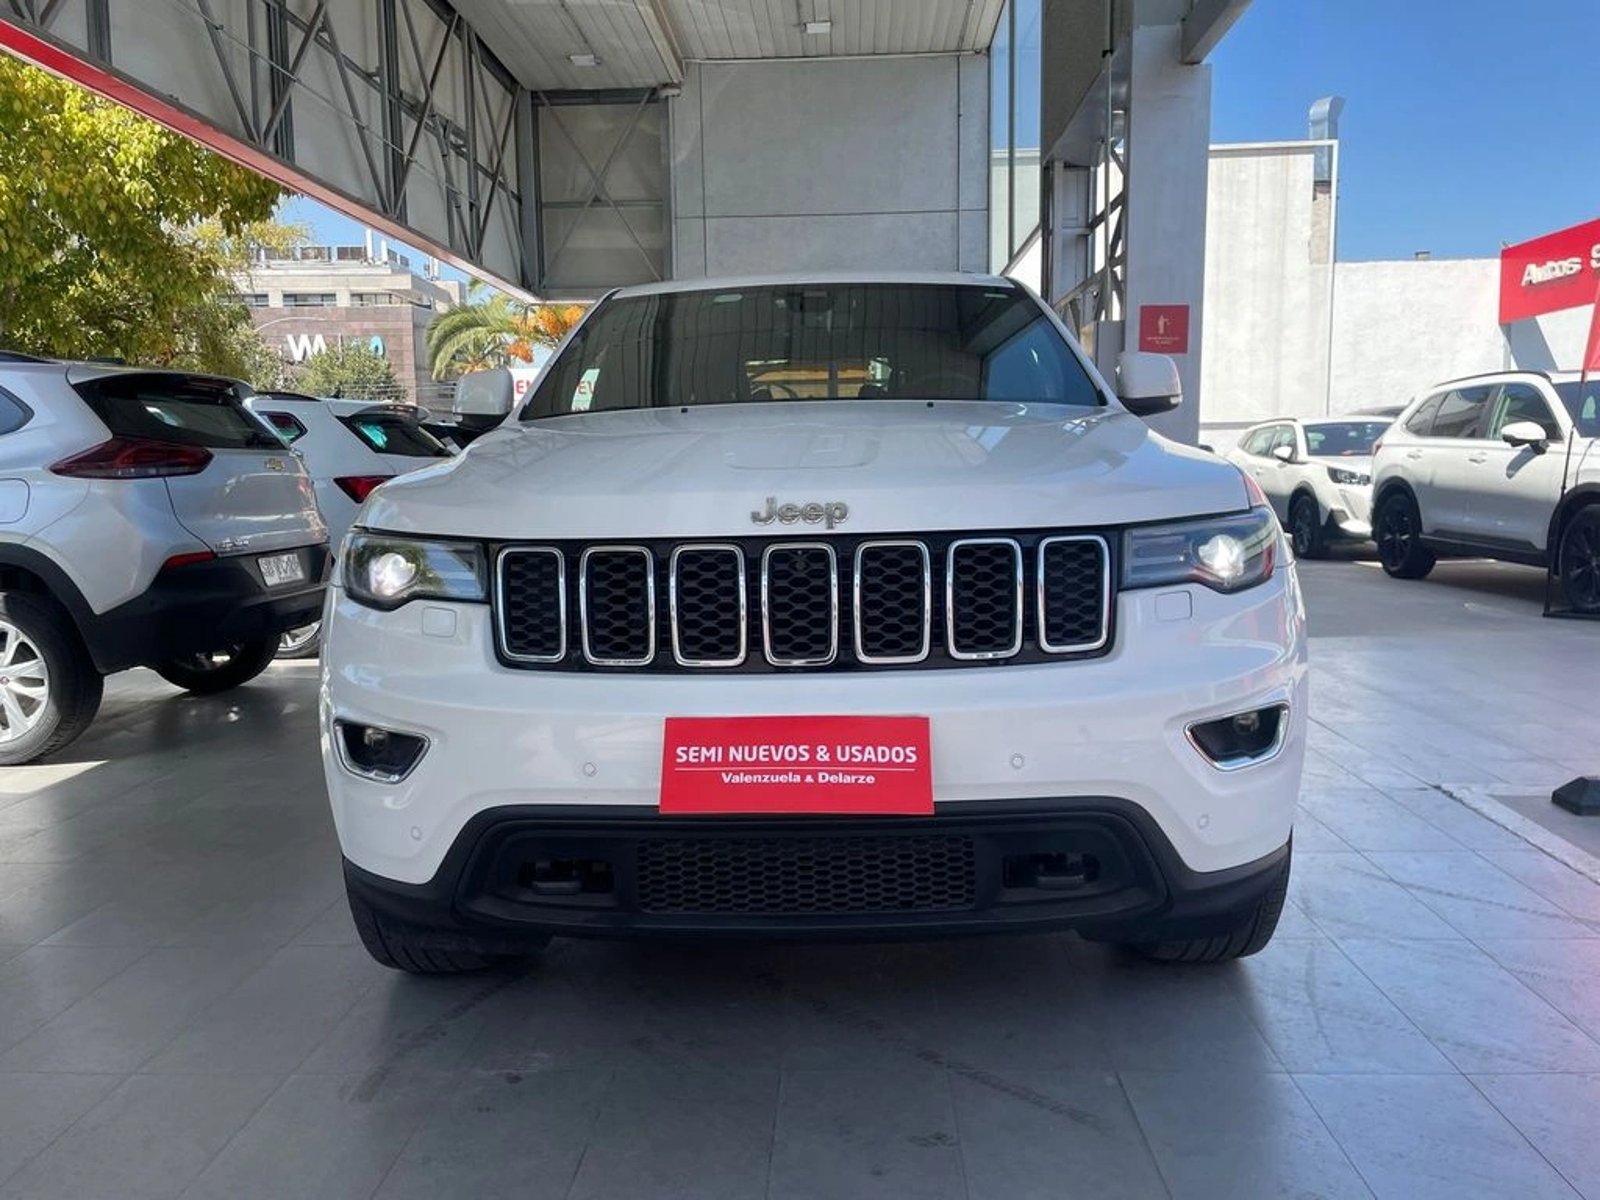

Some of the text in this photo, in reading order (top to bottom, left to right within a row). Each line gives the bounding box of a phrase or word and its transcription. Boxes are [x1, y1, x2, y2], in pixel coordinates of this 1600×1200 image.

[1521, 257, 1582, 286] Autos
[750, 496, 849, 530] Jeep
[676, 745, 918, 763] SEMI NUEVOS & USADOS
[721, 772, 876, 784] Valenzuela & Delarze
